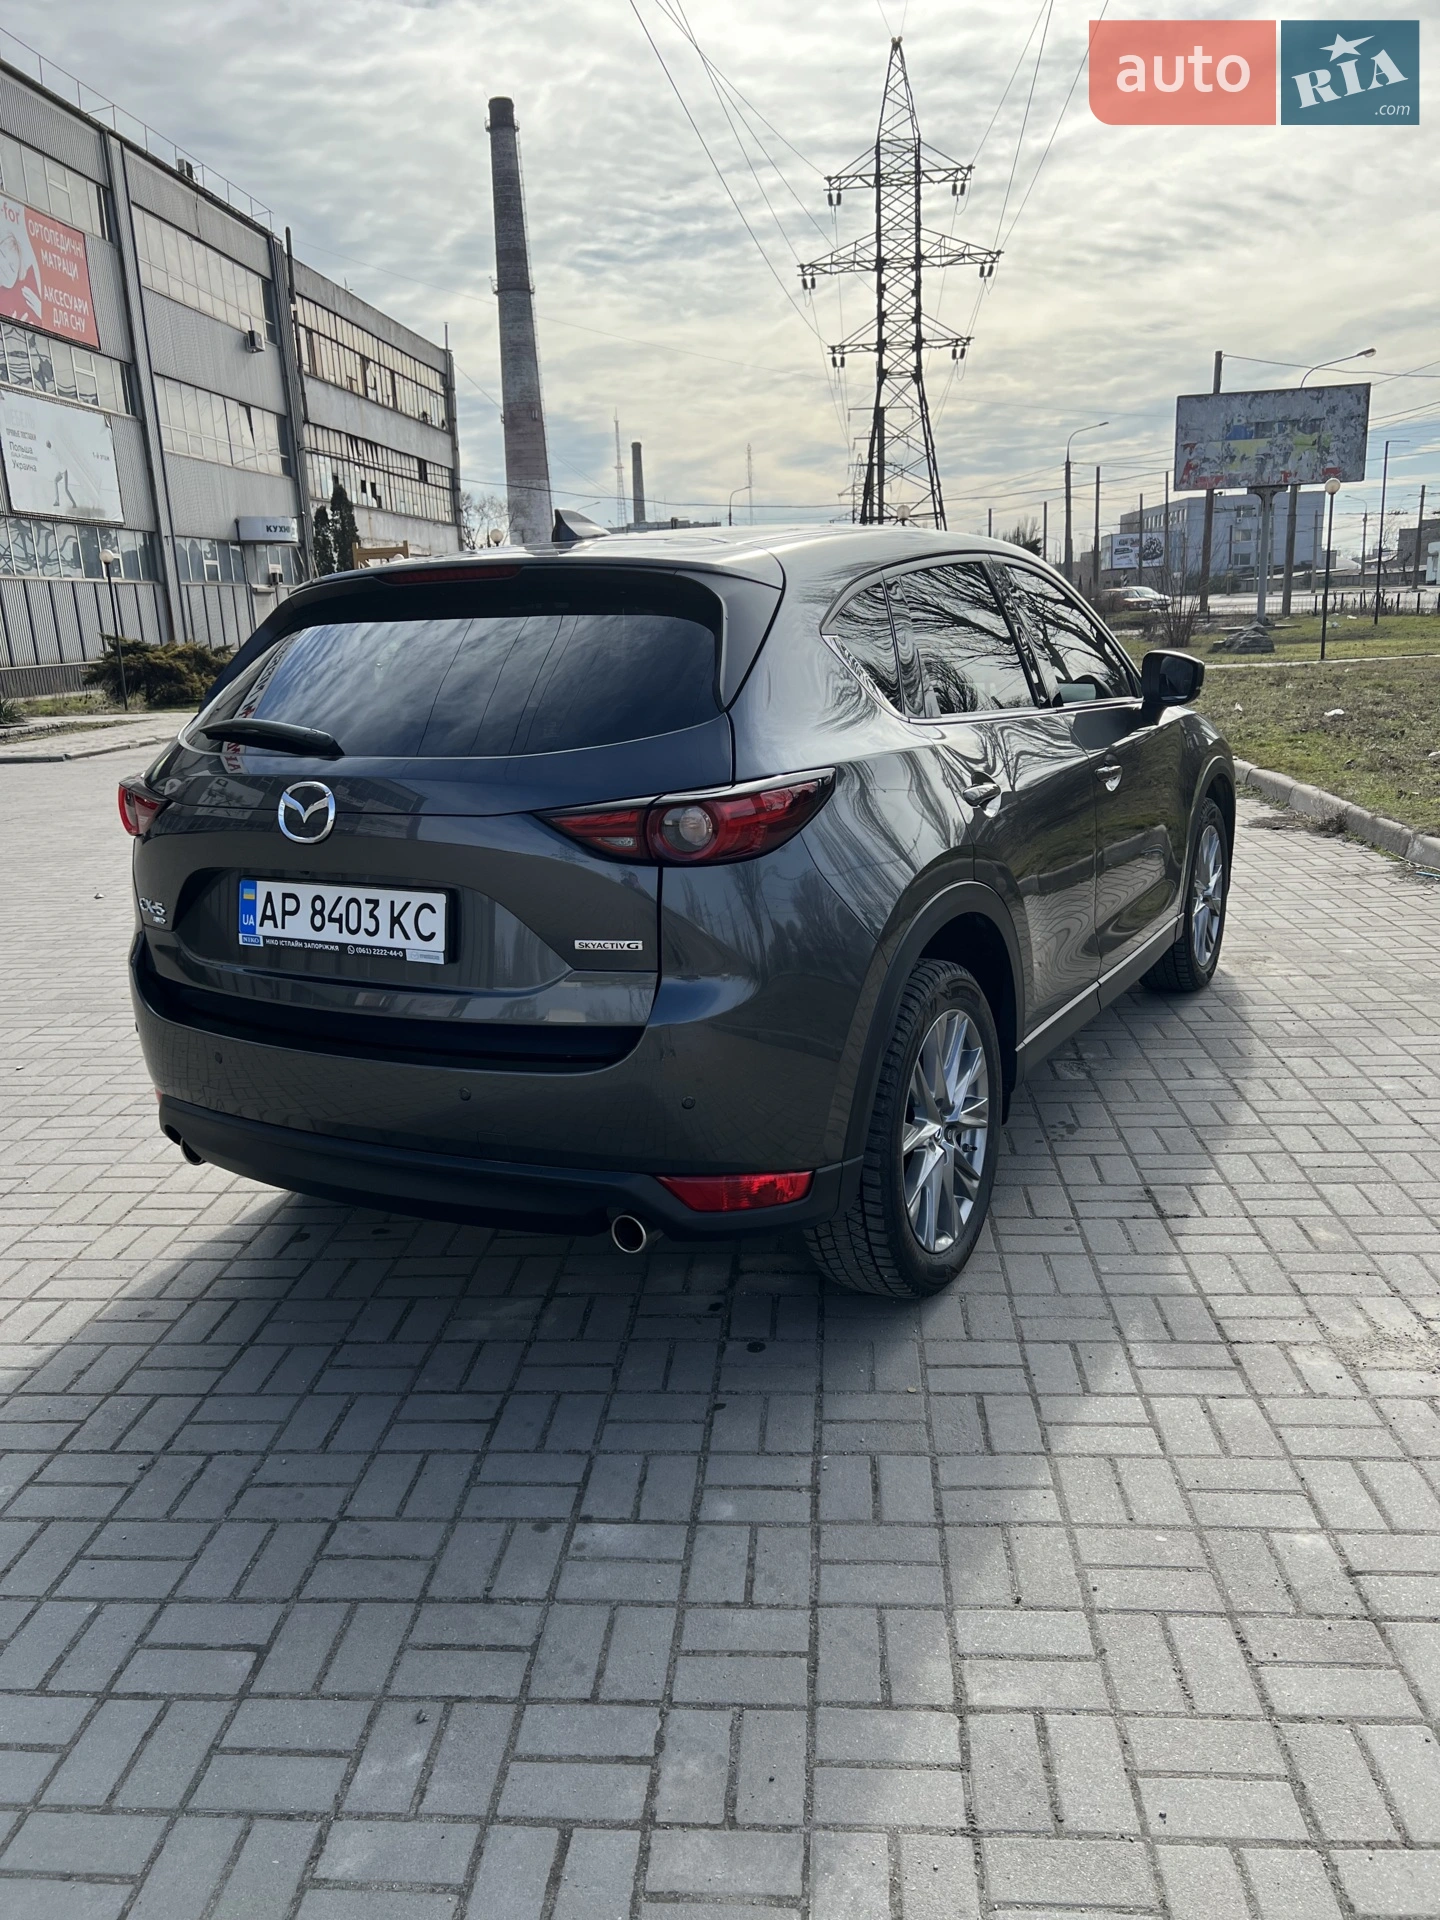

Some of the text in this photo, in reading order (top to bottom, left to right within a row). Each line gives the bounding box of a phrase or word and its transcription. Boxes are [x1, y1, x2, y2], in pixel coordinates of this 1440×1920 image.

[28, 219, 84, 258] ОРТОПЕДИЧНІ
[41, 248, 79, 281] МАТРАЦИ
[44, 285, 90, 316] АКСЕСУАРИ
[53, 308, 86, 333] ДЛЯ СНУ
[9, 441, 34, 455] Польша
[12, 459, 37, 472] Украина
[140, 897, 166, 916] CX-5
[242, 914, 255, 926] UA
[259, 891, 437, 942] AP 8403 KC
[242, 936, 260, 944] NIKO
[303, 942, 339, 952] ЗАПОРІЖЖЯ
[372, 948, 403, 957] 2222-44-0
